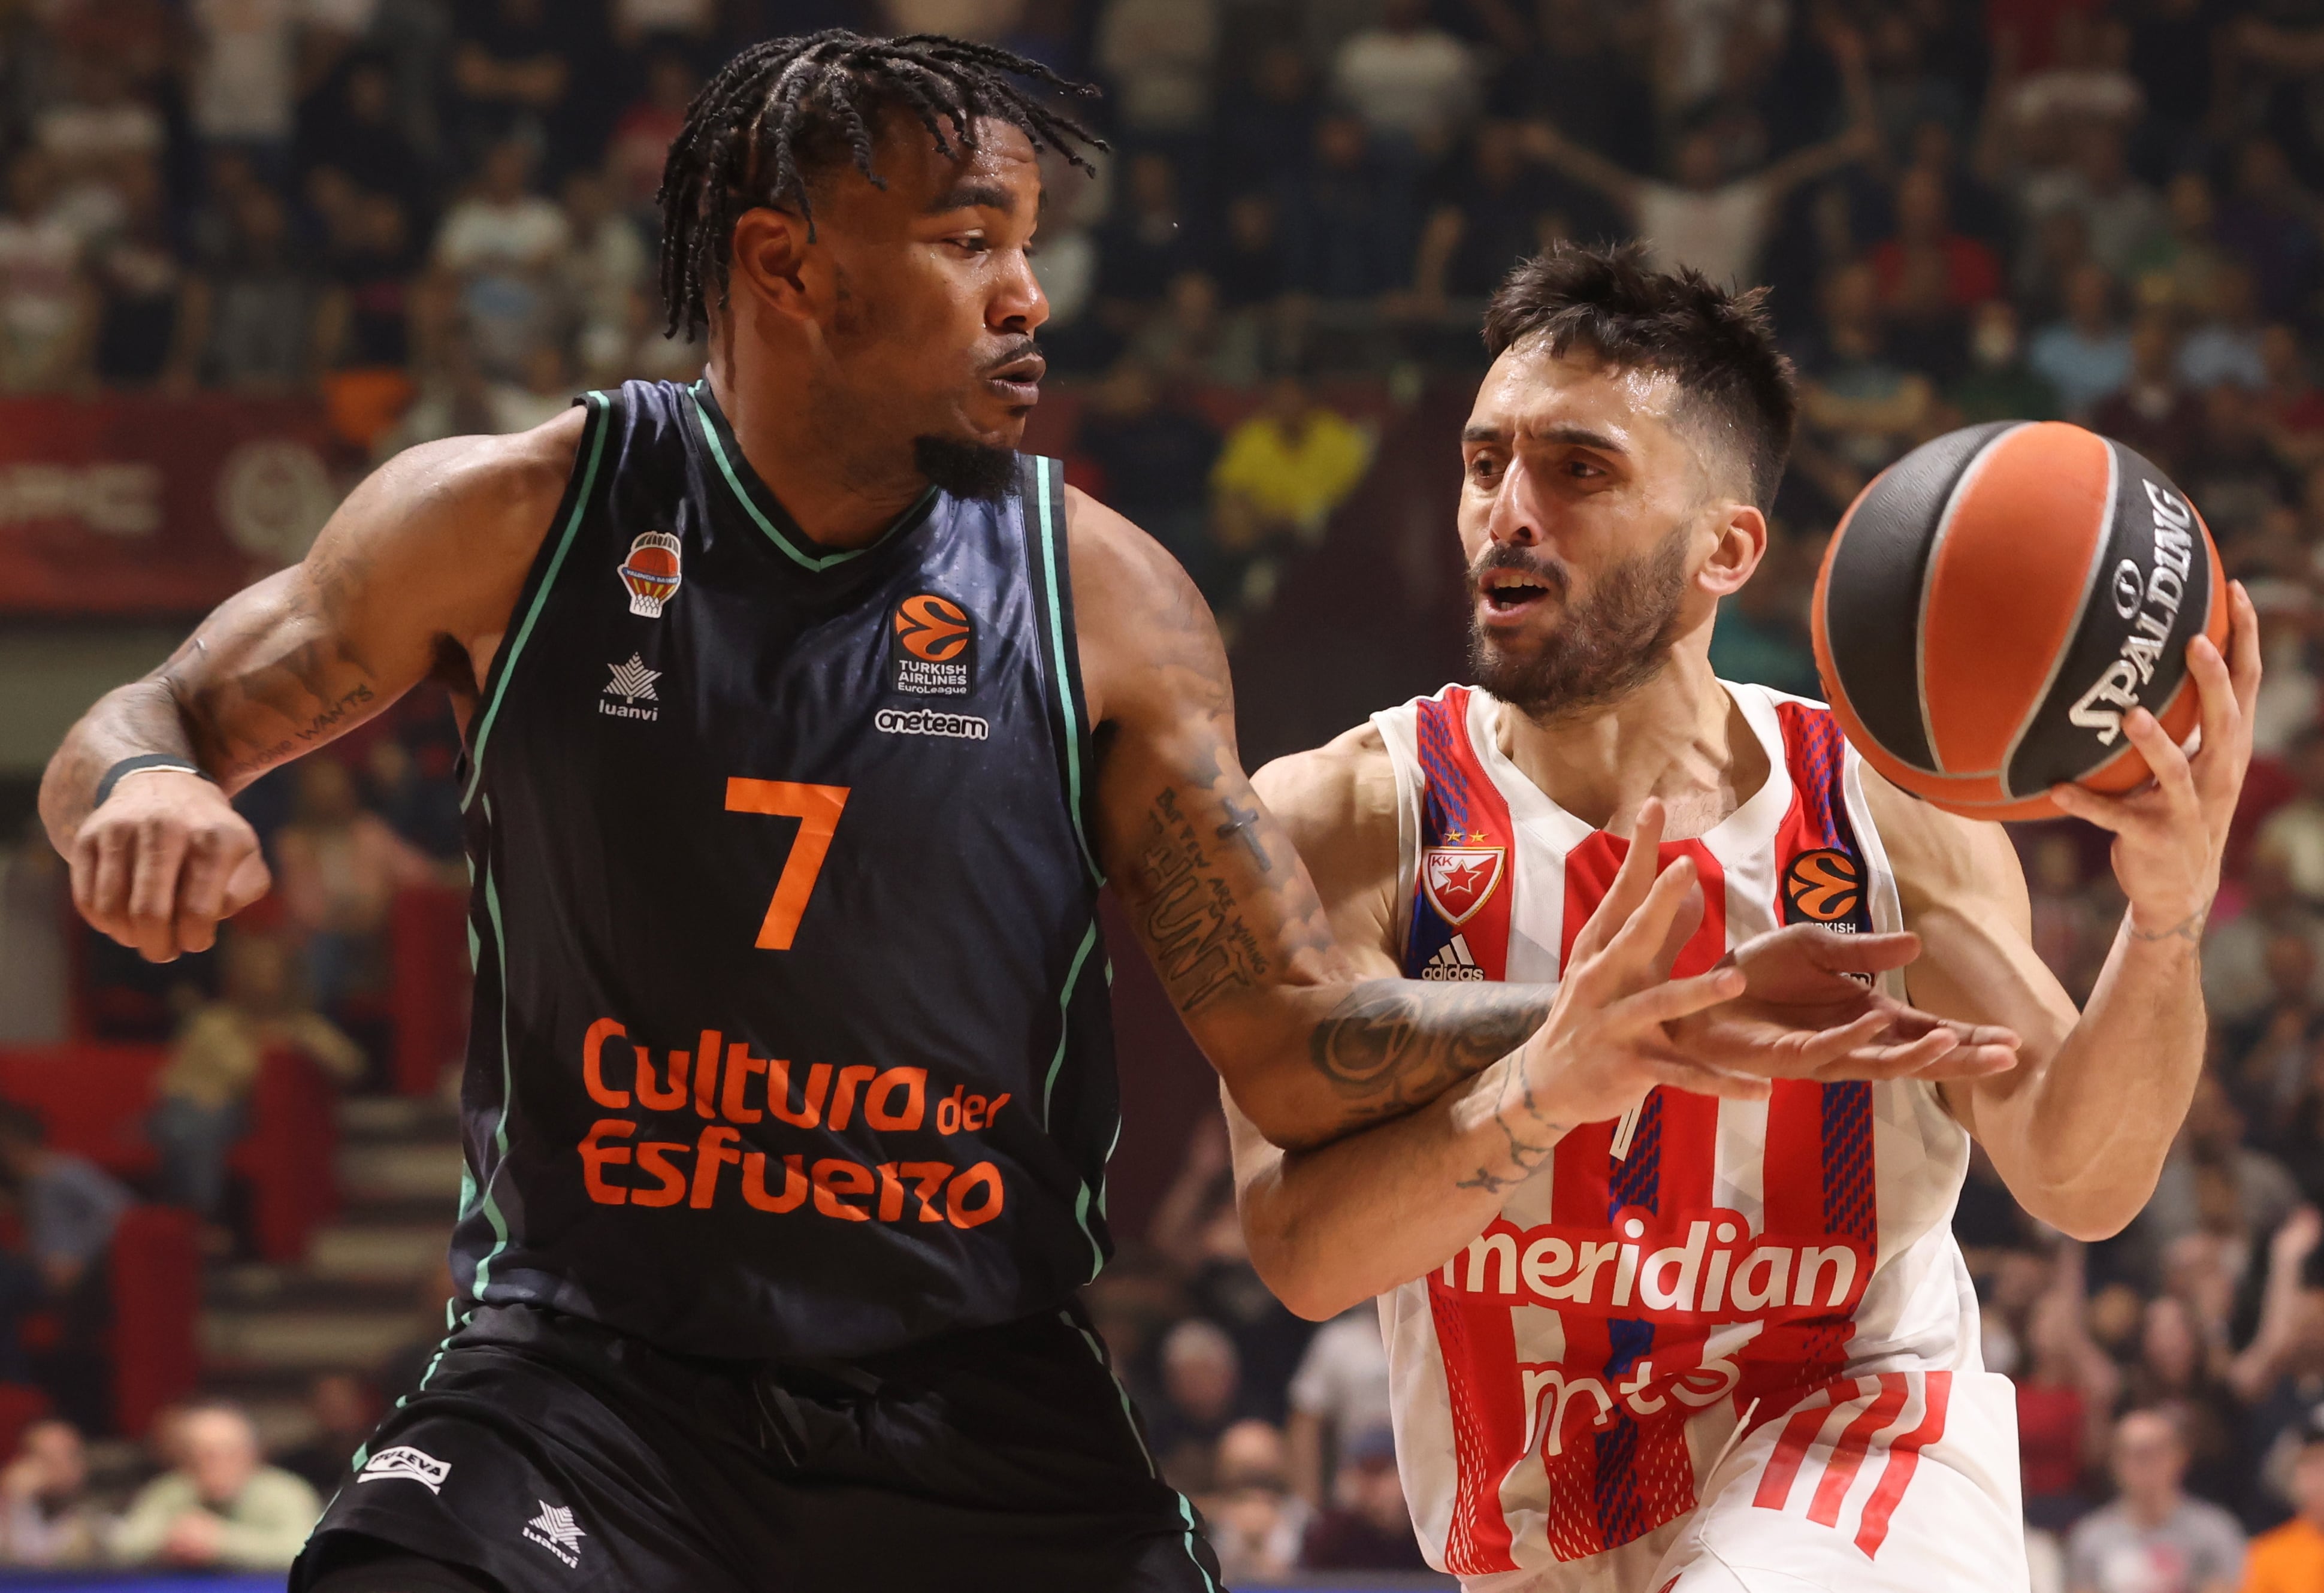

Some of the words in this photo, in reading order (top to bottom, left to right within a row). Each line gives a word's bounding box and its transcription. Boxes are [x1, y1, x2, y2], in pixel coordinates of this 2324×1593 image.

[2069, 477, 2192, 747] SPALDING
[898, 672, 967, 685] AIRLINES
[899, 660, 967, 675] TURKISH
[897, 682, 967, 695] EuroLeague
[599, 699, 658, 721] luanvi
[877, 712, 986, 737] oneteam
[724, 776, 851, 951] 7
[1431, 856, 1453, 866] KK
[1421, 963, 1484, 981] adidas
[582, 1017, 927, 1131] Cultura
[577, 1119, 1005, 1229] Esfuerzo
[1444, 1218, 1858, 1312] meridian
[371, 1450, 442, 1476] PULEVA
[522, 1527, 579, 1568] luanvi
